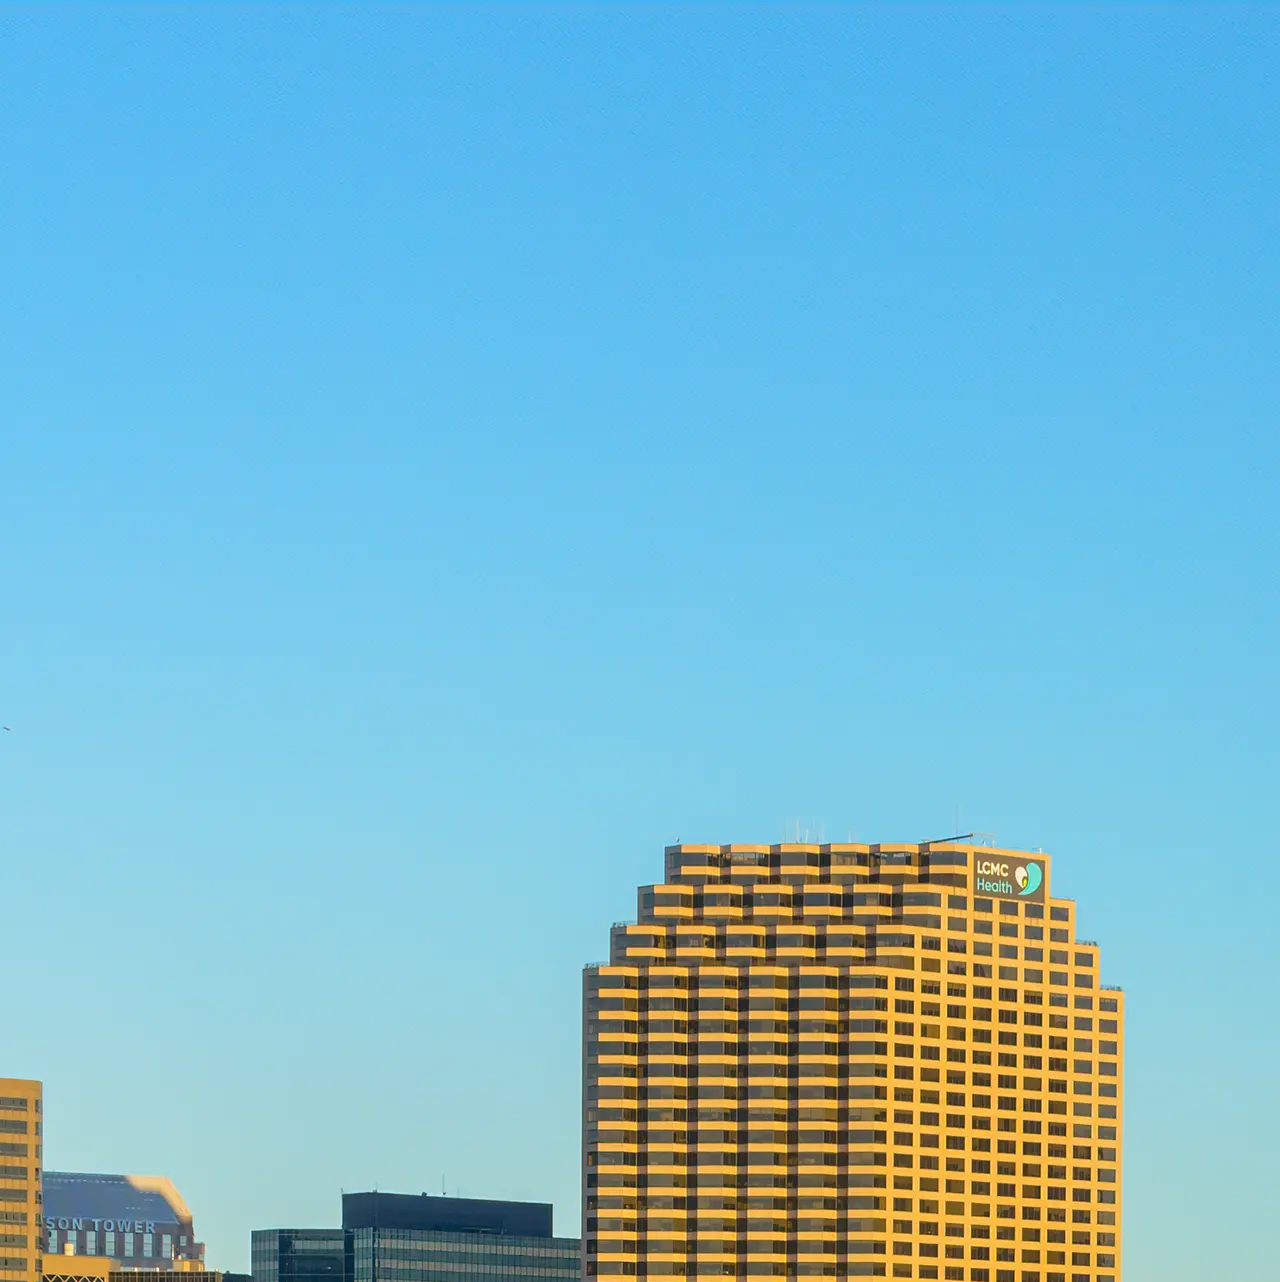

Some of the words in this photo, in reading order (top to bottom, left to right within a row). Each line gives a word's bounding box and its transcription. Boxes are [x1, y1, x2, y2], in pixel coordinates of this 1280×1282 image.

[977, 861, 1009, 877] LCMC
[977, 878, 1013, 894] Health
[41, 1216, 83, 1231] SON
[92, 1218, 156, 1234] TOWER
